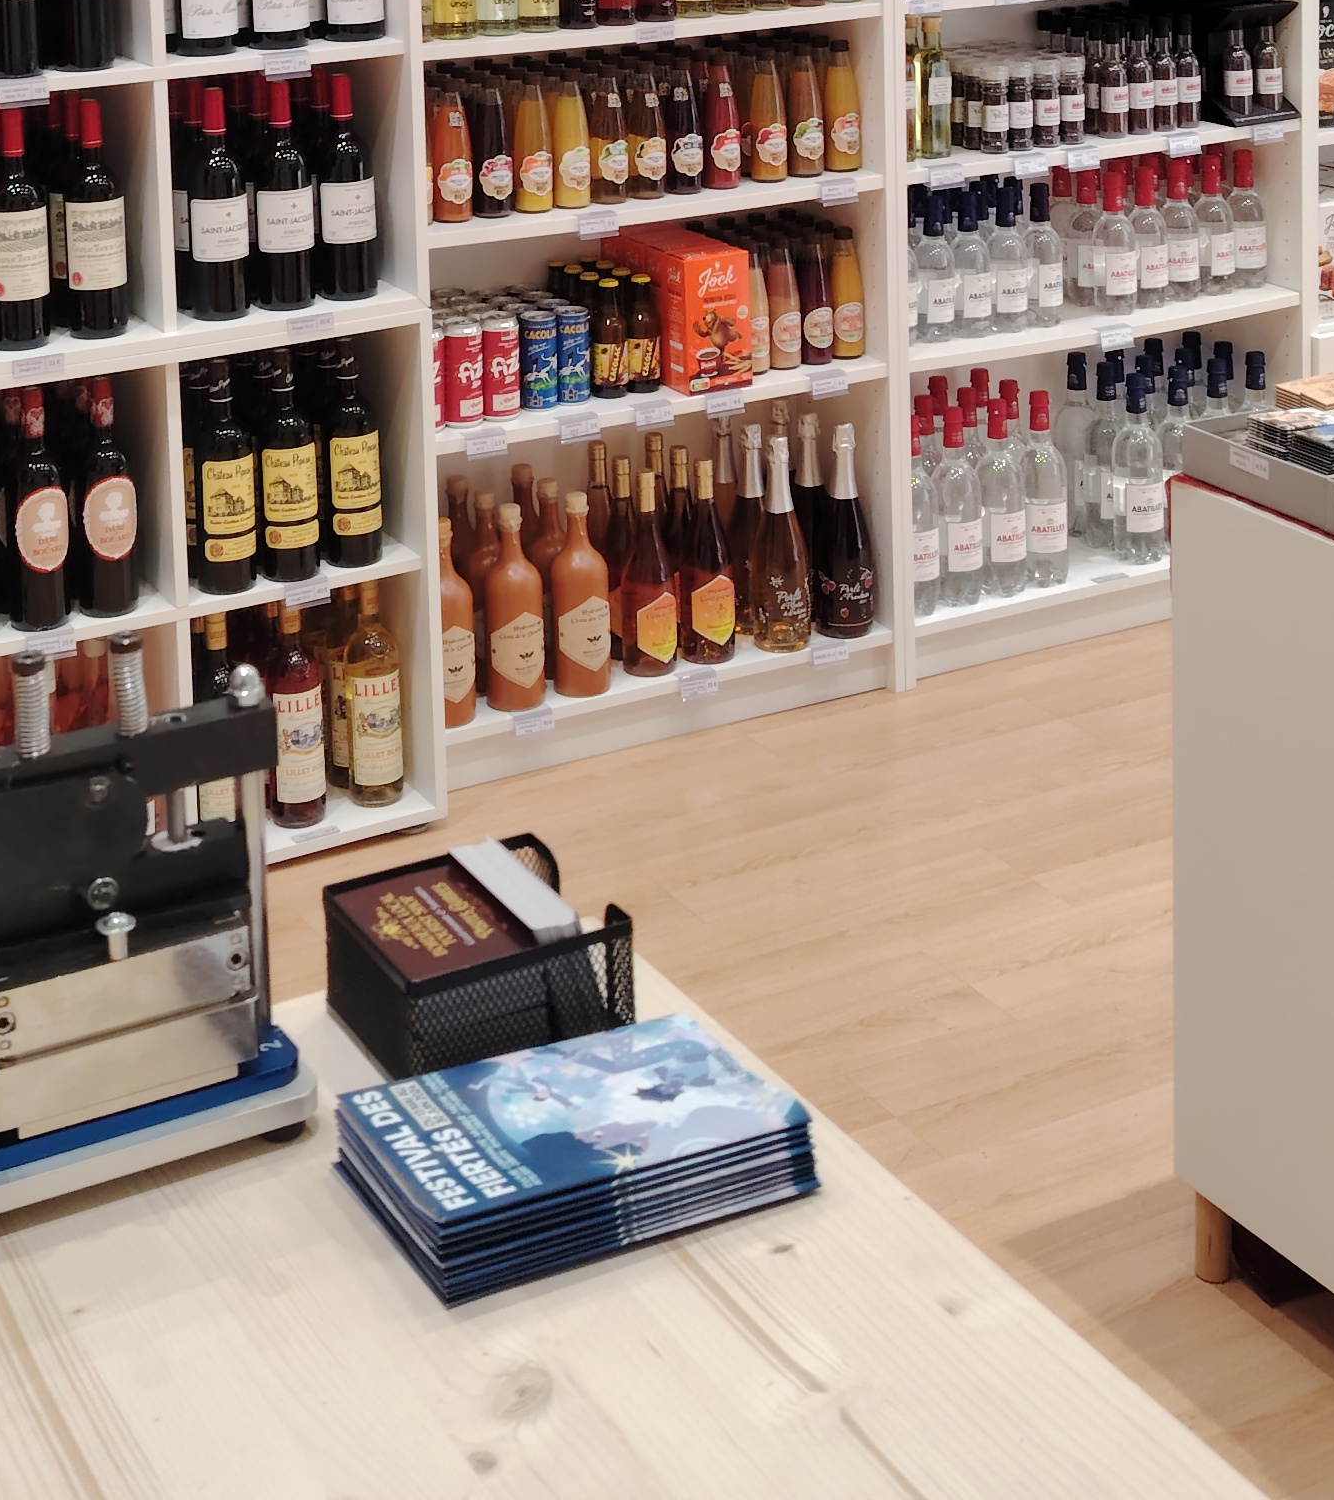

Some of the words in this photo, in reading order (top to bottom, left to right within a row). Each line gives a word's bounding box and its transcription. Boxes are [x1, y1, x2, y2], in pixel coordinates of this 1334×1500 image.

[698, 263, 738, 297] Jock
[608, 346, 621, 382] CACOLAC
[642, 341, 654, 377] CACOLAC
[286, 768, 310, 776] LILLET
[360, 751, 385, 759] LILLET
[205, 787, 229, 796] LILLET
[352, 1090, 404, 1129] DES
[383, 1124, 478, 1212] FESTIVAL
[430, 1127, 518, 1199] FIERTÉS
